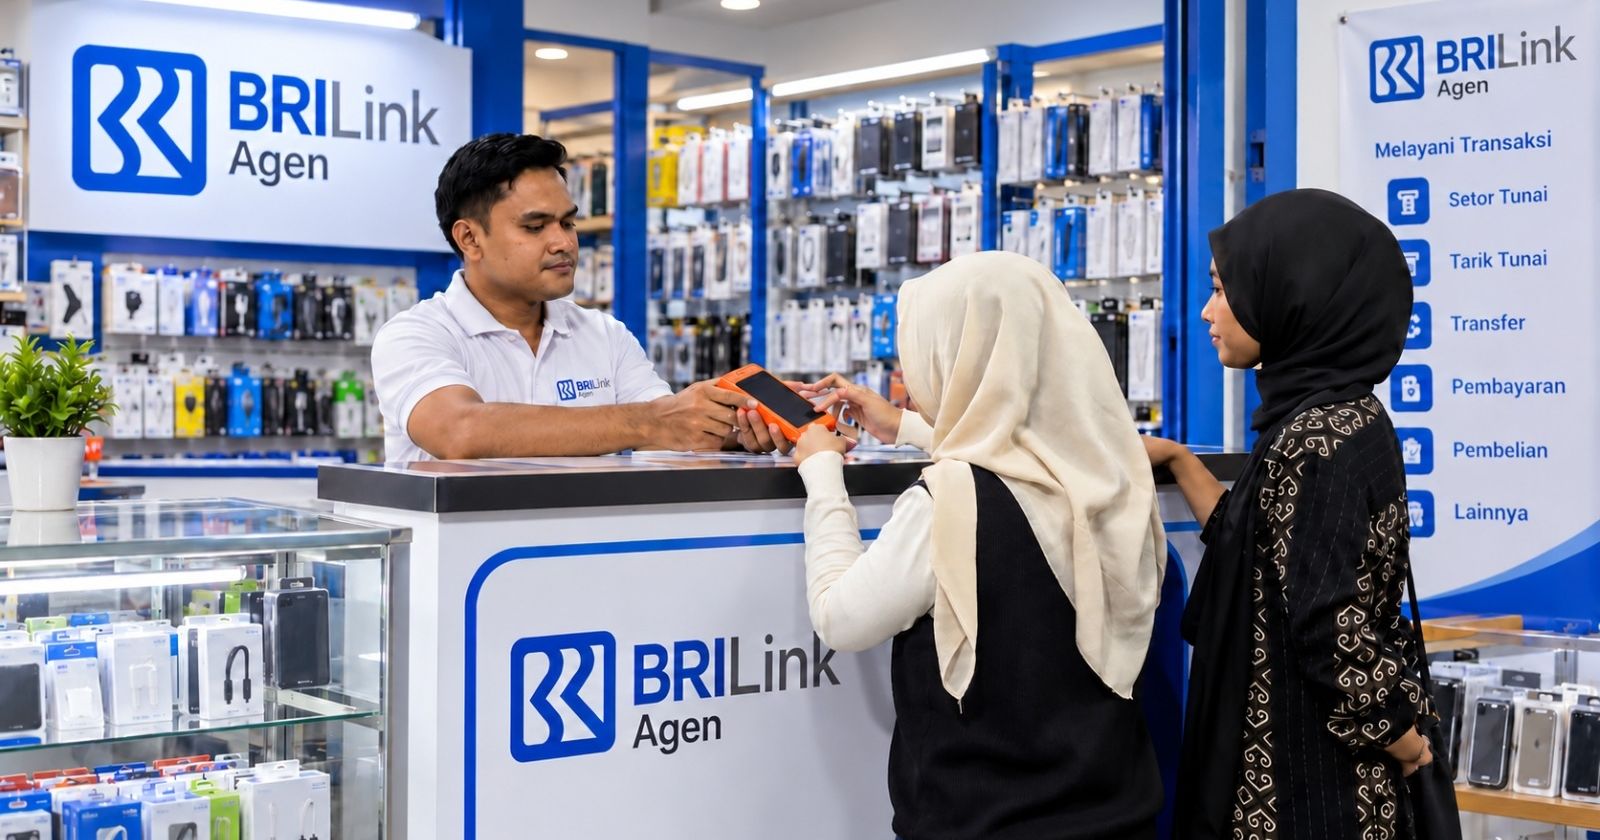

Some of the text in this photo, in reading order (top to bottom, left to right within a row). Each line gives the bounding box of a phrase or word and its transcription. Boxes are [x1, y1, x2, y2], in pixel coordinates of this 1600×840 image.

[1437, 26, 1577, 74] BRILink
[1437, 79, 1489, 100] Agen
[229, 71, 440, 146] BRILink
[1375, 130, 1552, 161] Melayani Transaksi
[229, 141, 329, 187] Agen
[1449, 186, 1548, 207] Setor Tunai
[1450, 249, 1547, 269] Tarik Tunai
[1450, 314, 1526, 331] Transfer
[1452, 378, 1566, 399] Pembayaran
[1453, 441, 1548, 459] Pembelian
[1454, 503, 1529, 525] Lainnya
[634, 630, 841, 706] BRILink
[632, 714, 722, 755] Agen
